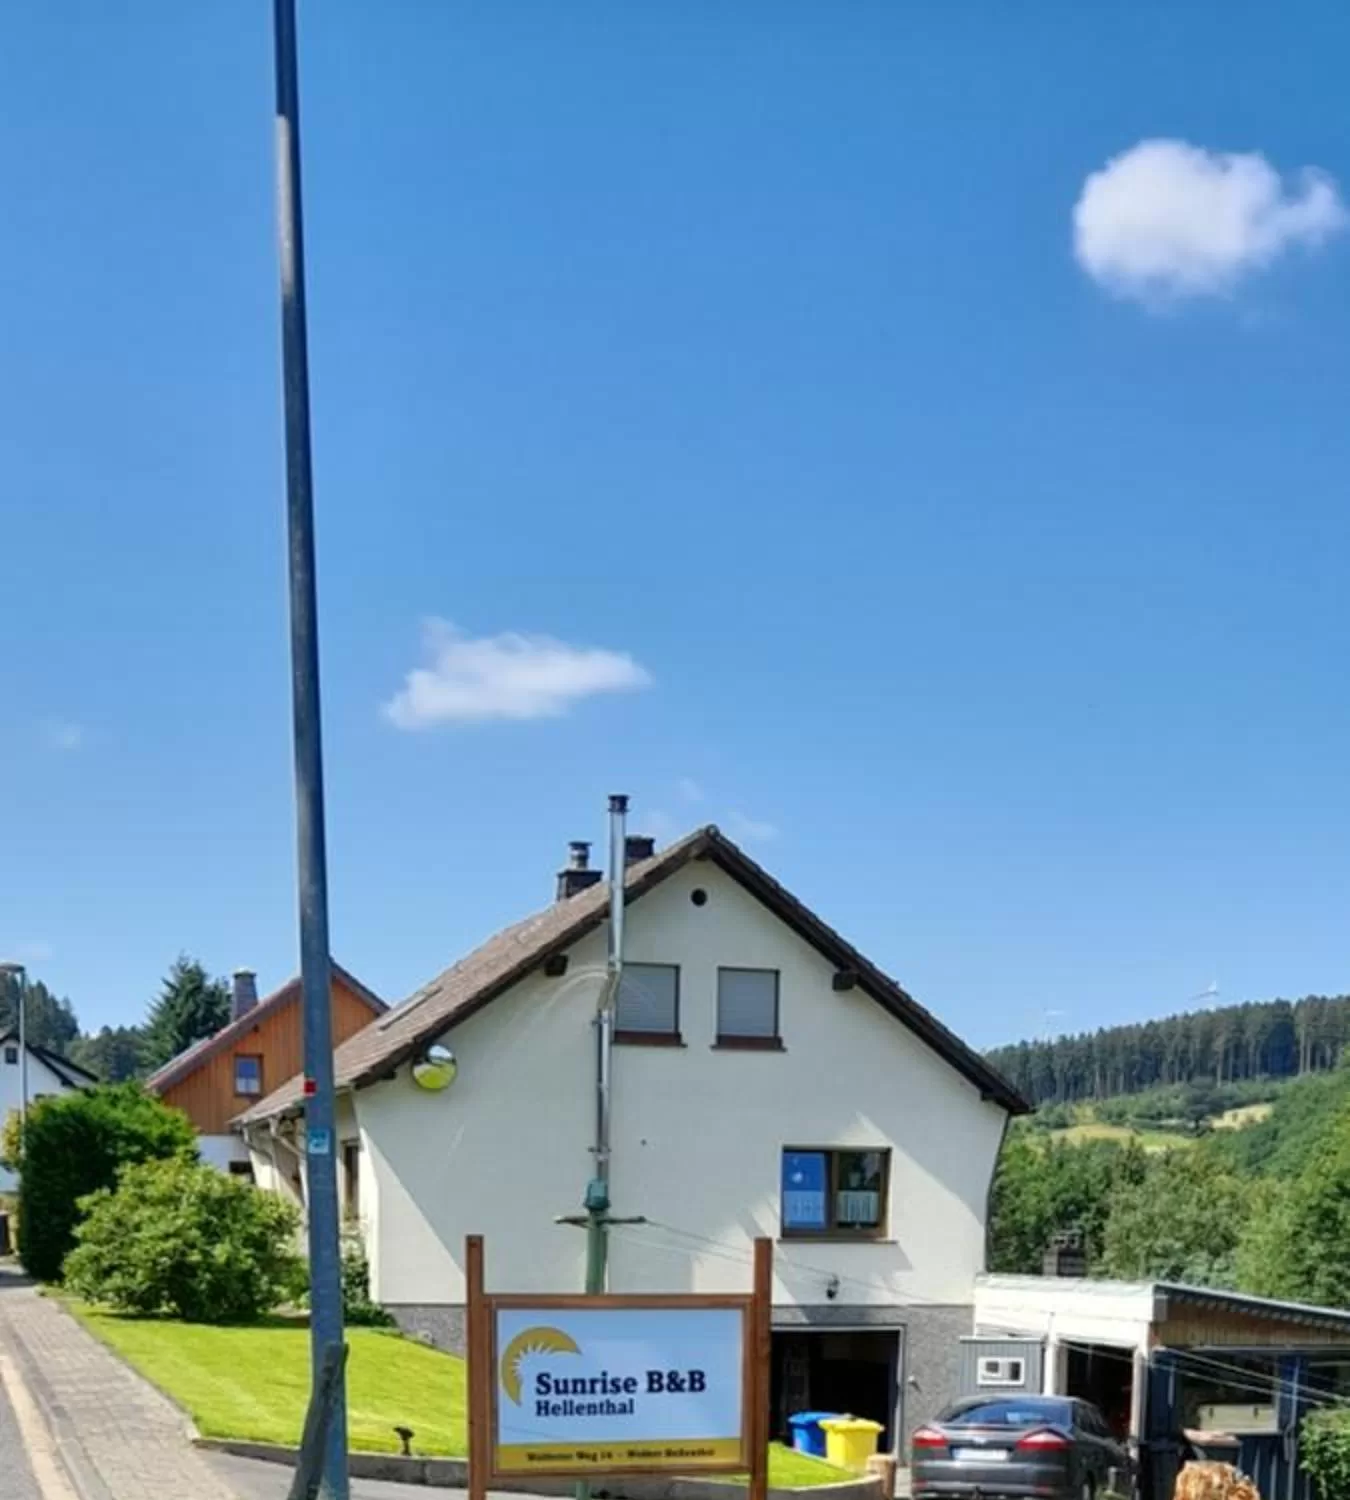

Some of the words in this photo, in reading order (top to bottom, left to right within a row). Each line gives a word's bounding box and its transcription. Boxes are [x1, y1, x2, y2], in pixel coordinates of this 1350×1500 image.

[535, 1371, 638, 1396] Sunrise
[646, 1370, 707, 1393] B&B
[535, 1398, 635, 1417] Hellenthal
